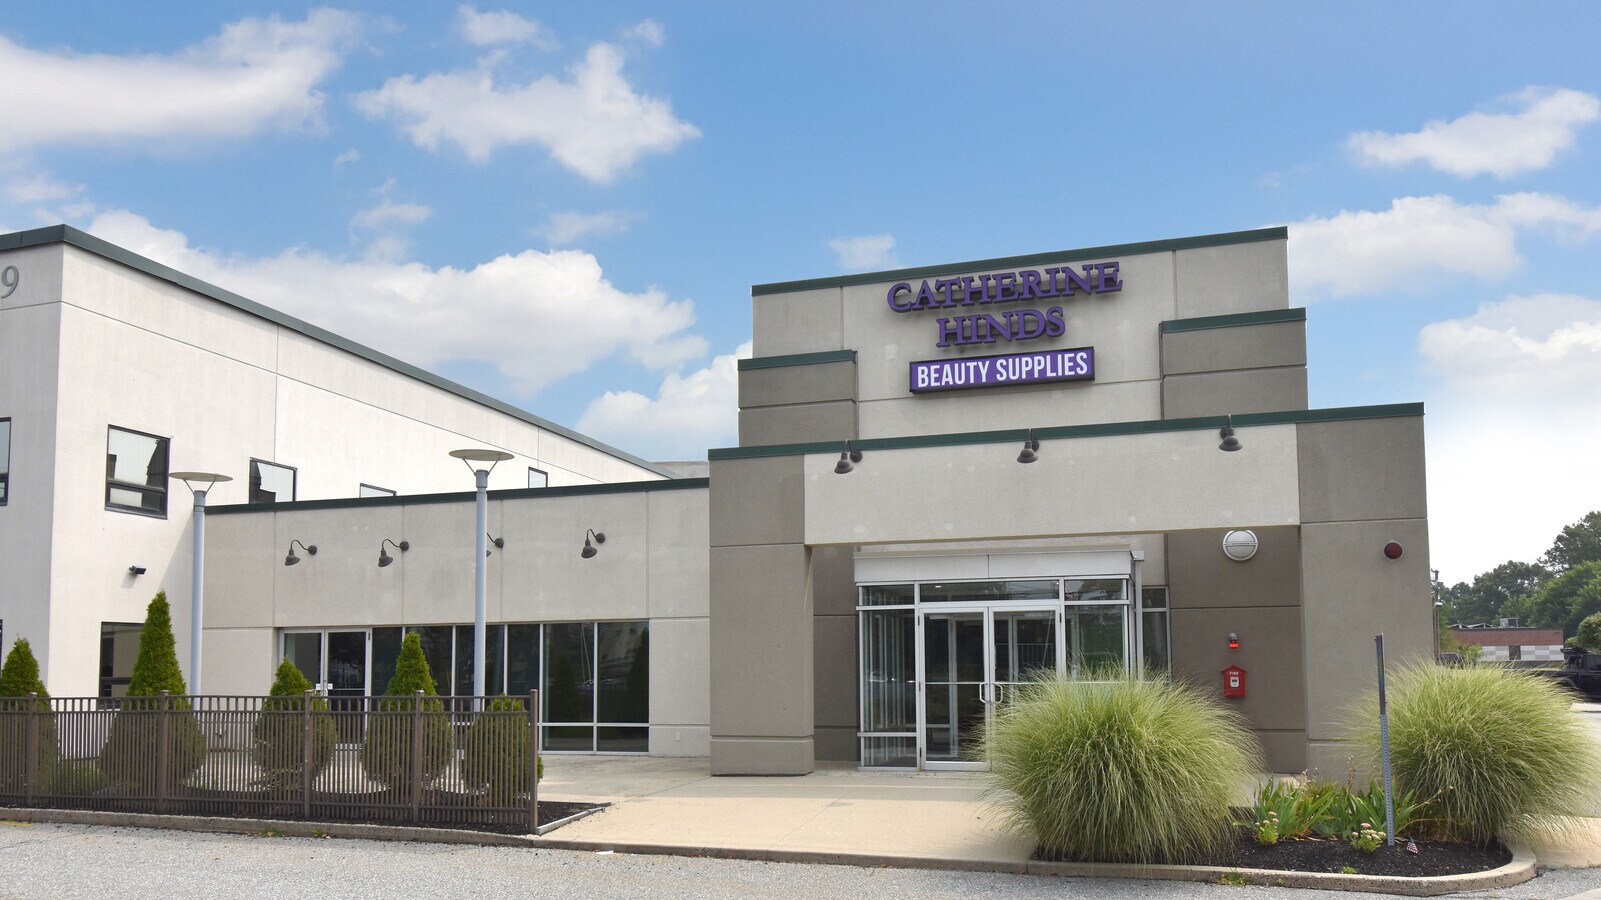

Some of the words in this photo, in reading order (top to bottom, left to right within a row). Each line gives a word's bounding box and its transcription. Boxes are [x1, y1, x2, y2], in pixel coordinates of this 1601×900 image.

[1, 265, 19, 299] 9
[887, 262, 1123, 312] CATHERINE
[936, 306, 1065, 347] HINDS
[917, 360, 990, 387] BEAUTY
[996, 352, 1088, 381] SUPPLIES
